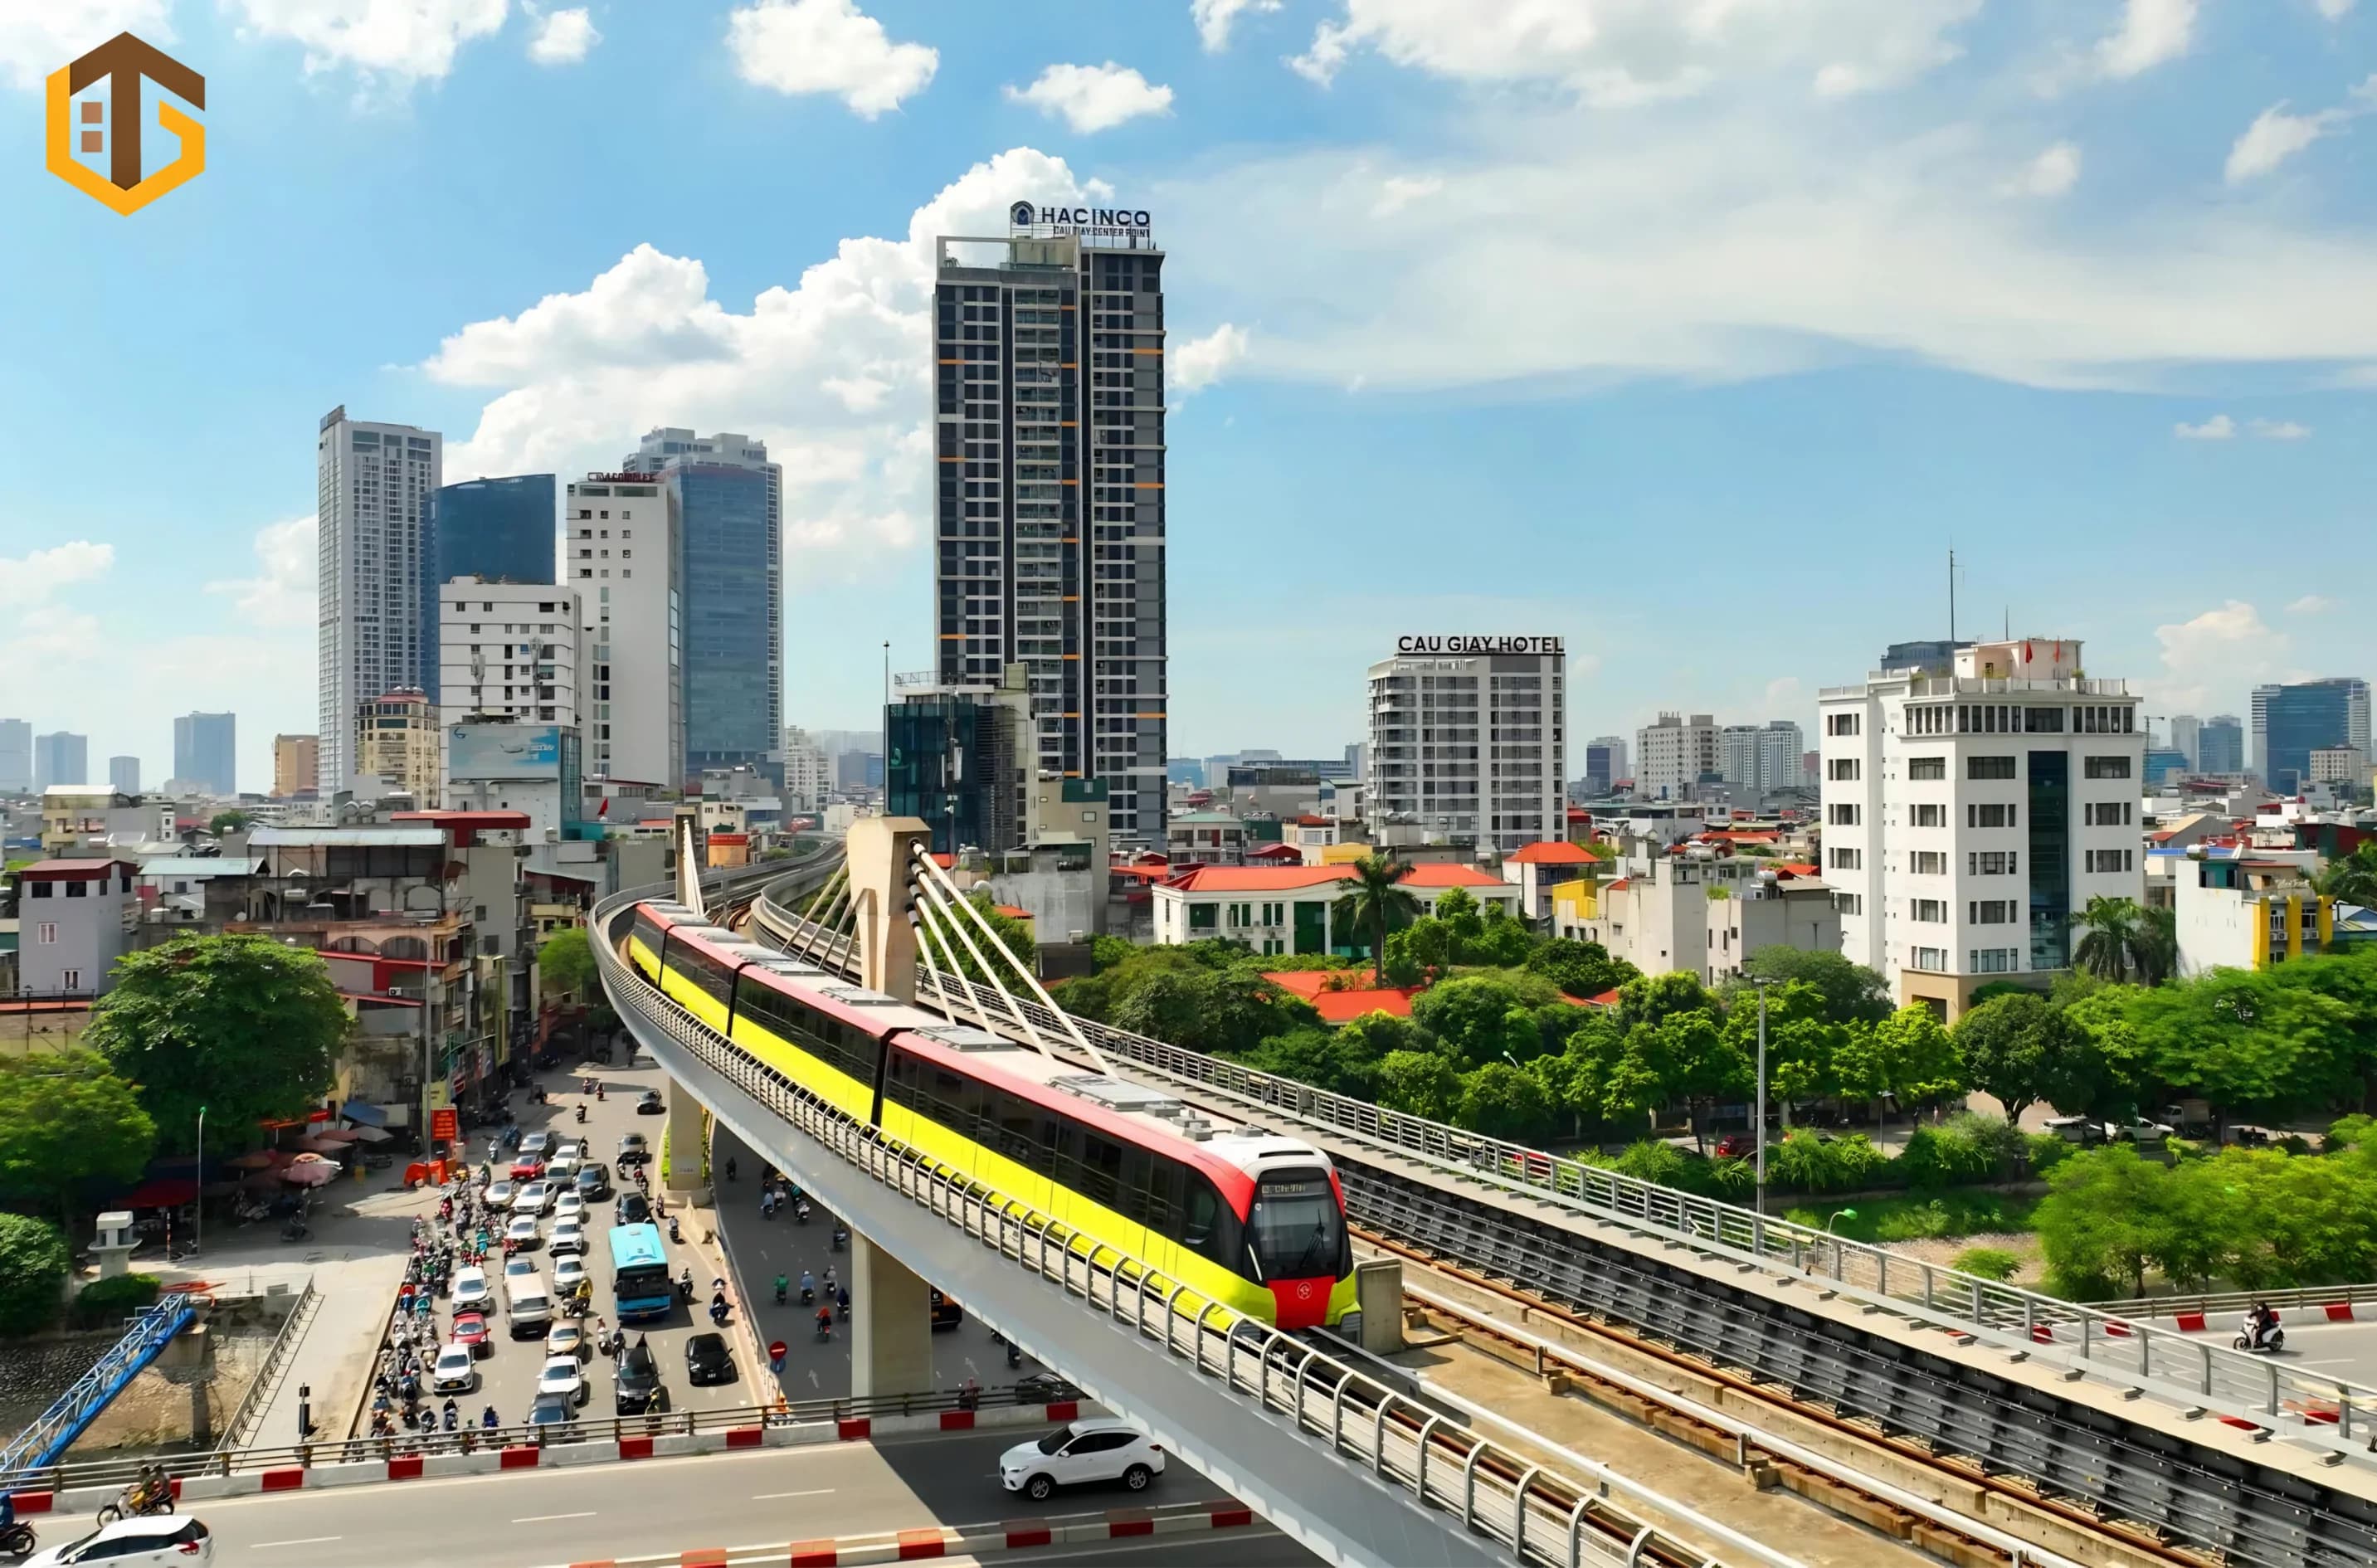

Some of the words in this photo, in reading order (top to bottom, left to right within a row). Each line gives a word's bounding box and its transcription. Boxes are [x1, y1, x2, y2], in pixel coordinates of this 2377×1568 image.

[1042, 207, 1150, 226] HACINCO
[1093, 226, 1123, 237] CENTER
[1125, 228, 1149, 239] POINT
[1398, 635, 1441, 651] CAU
[1447, 635, 1493, 652] GIAY
[1498, 636, 1565, 652] HOTEL
